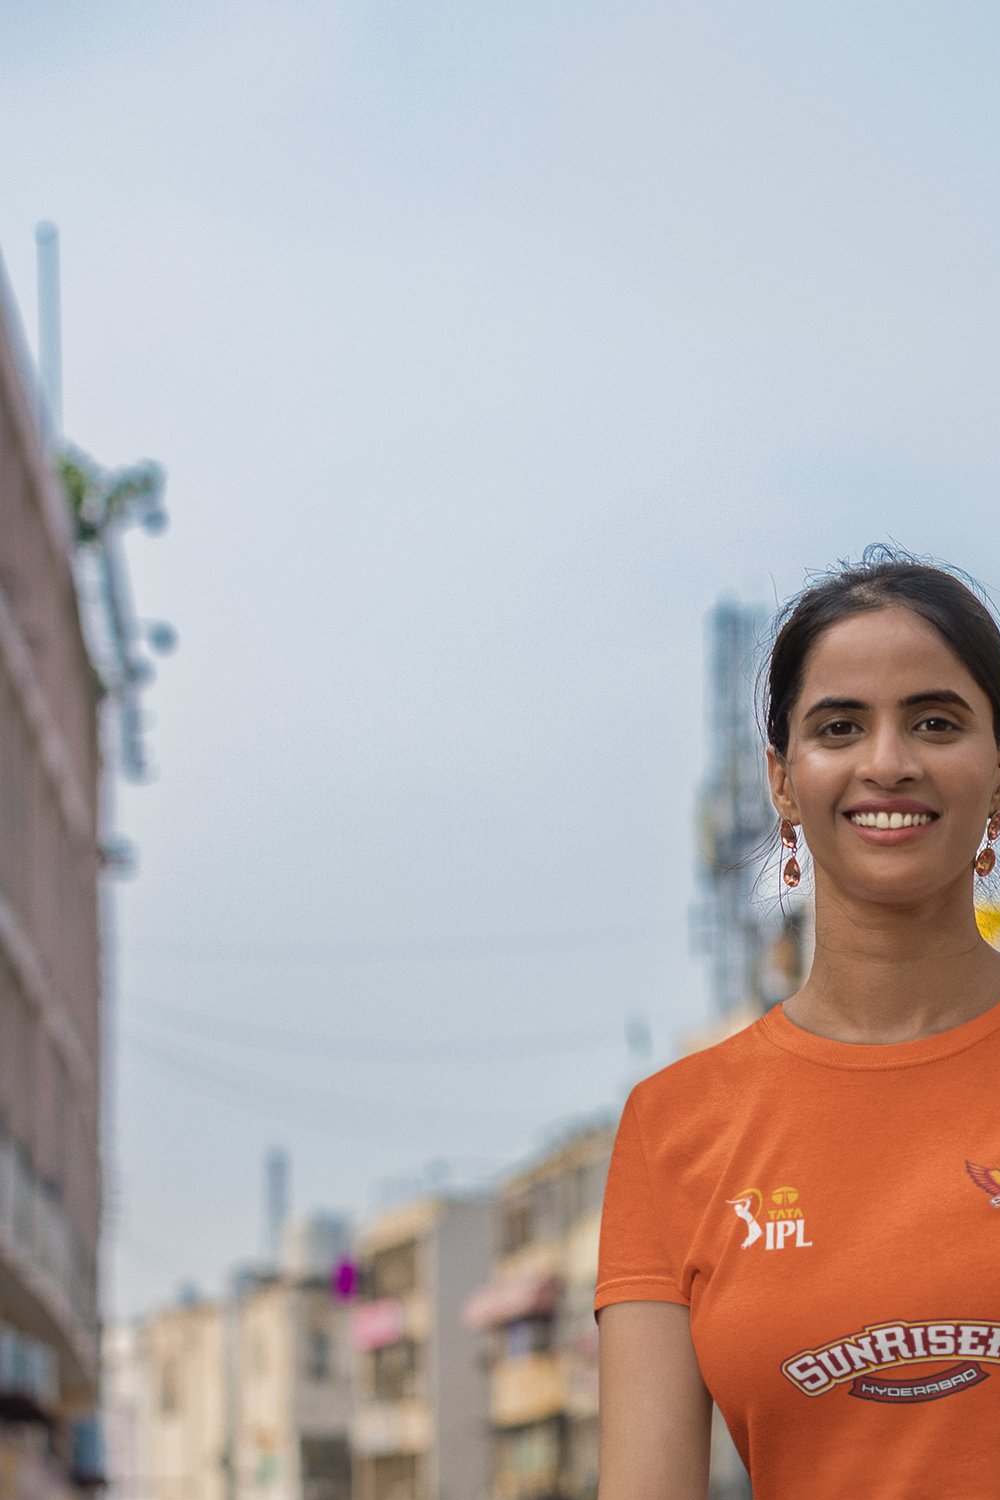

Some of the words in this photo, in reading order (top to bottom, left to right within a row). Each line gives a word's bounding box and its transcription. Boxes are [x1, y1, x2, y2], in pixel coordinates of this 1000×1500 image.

[767, 1207, 804, 1220] TATA
[765, 1219, 813, 1250] IPL
[861, 1367, 978, 1398] HYDERABAD
